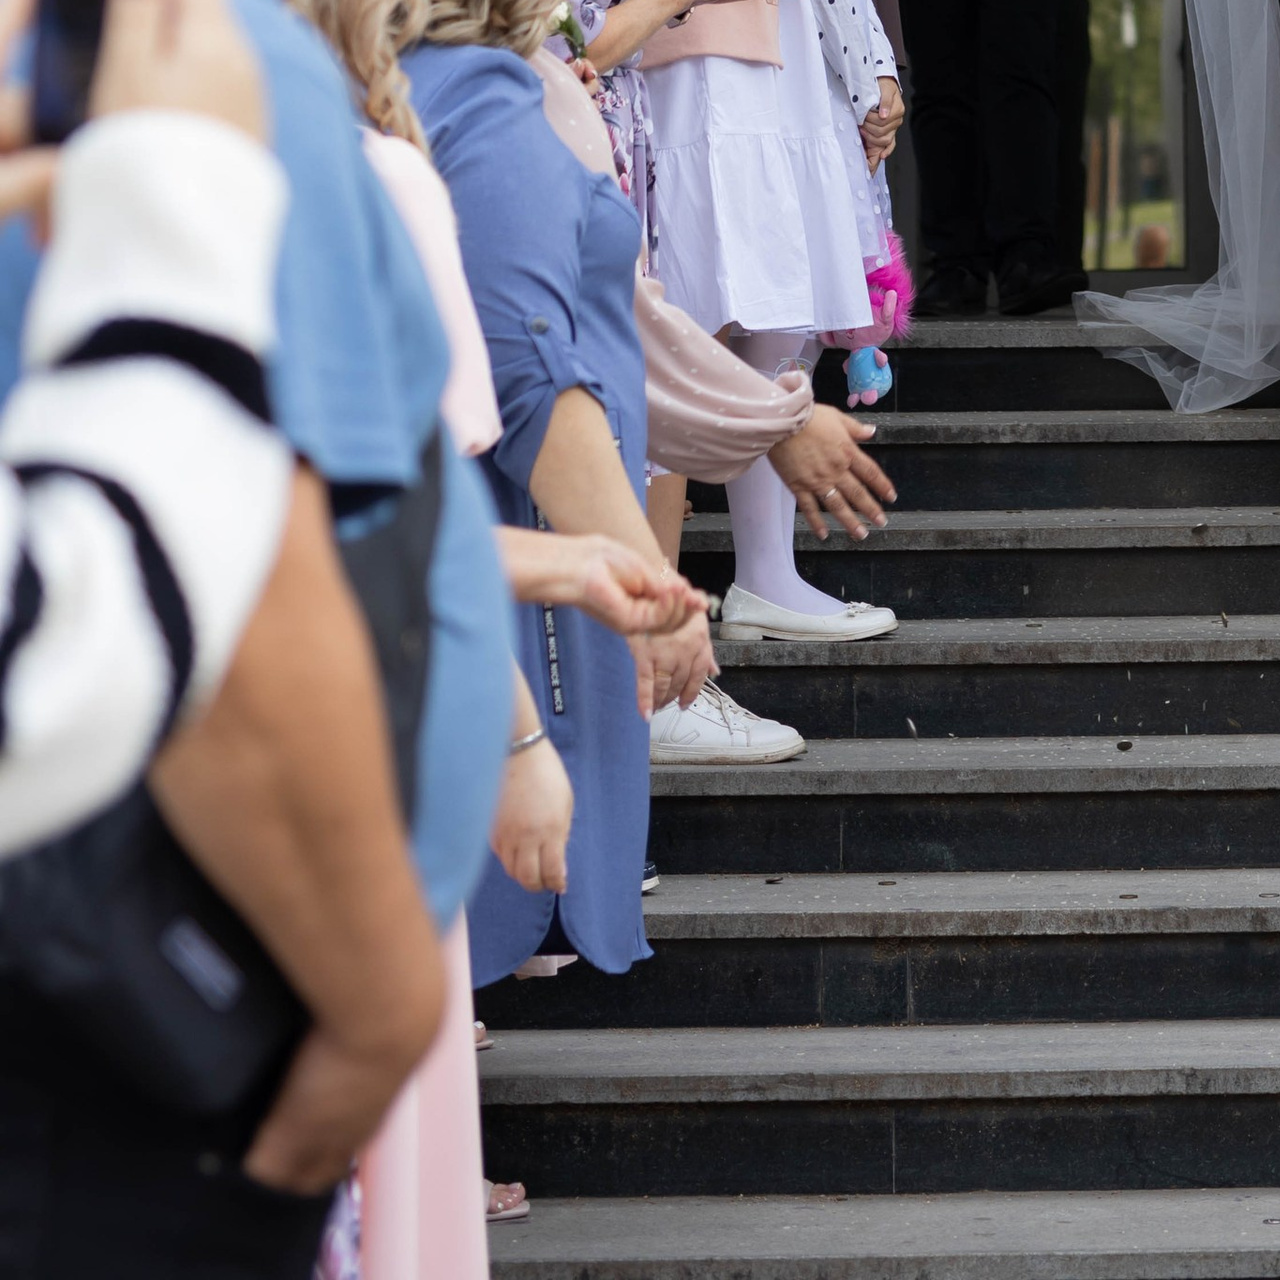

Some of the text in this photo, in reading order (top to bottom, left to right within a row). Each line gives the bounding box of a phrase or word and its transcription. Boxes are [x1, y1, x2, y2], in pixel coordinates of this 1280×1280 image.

[545, 610, 554, 635] NICE
[548, 636, 557, 661] NICE
[550, 662, 559, 687] NICE
[553, 687, 563, 712] NICE
